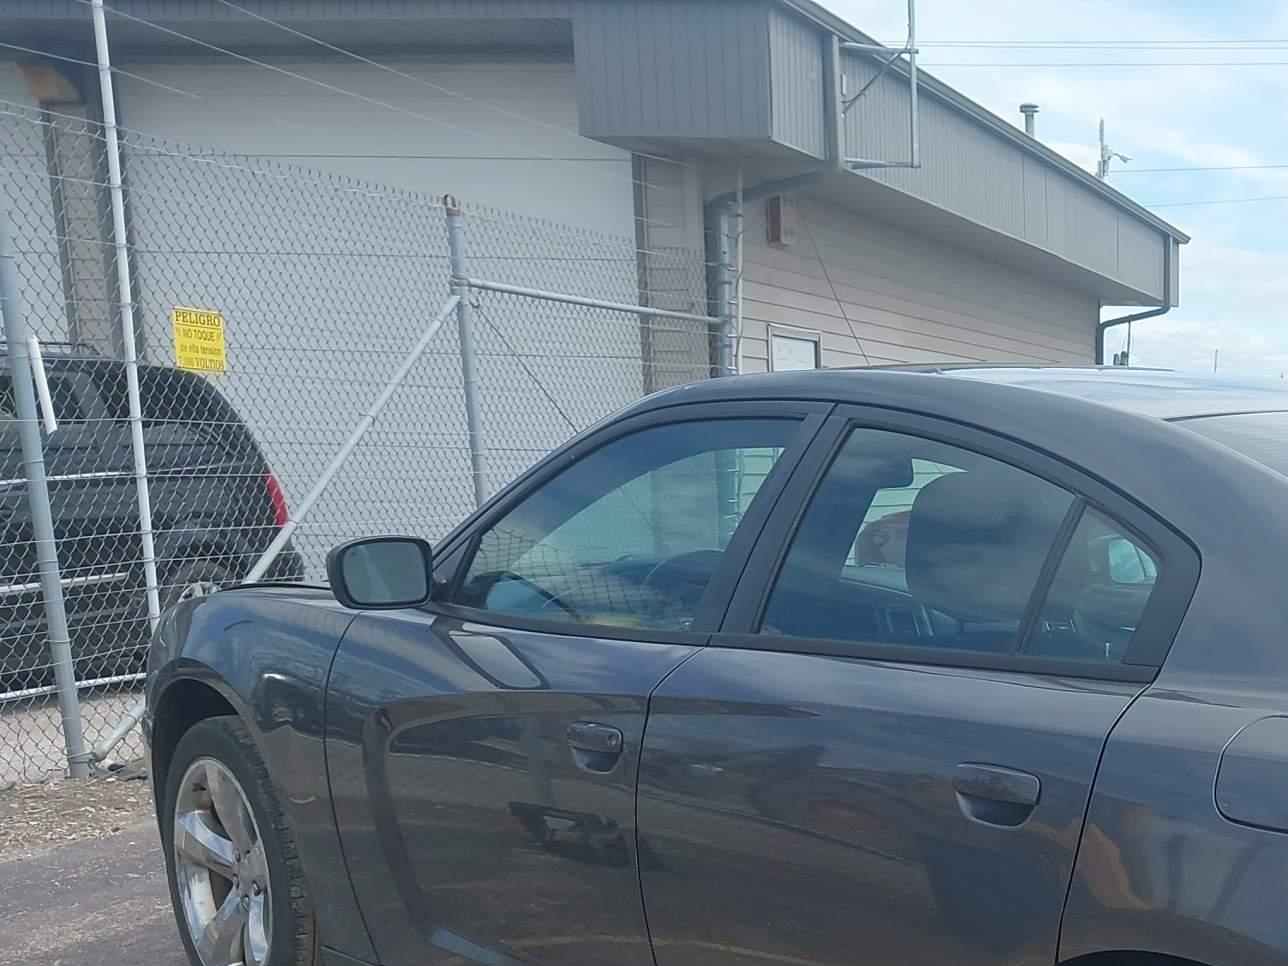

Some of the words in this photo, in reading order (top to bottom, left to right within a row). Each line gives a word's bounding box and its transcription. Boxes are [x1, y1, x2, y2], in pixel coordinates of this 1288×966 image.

[175, 310, 221, 328] PELIGRO
[183, 328, 193, 339] NO
[194, 329, 216, 342] TOQUE
